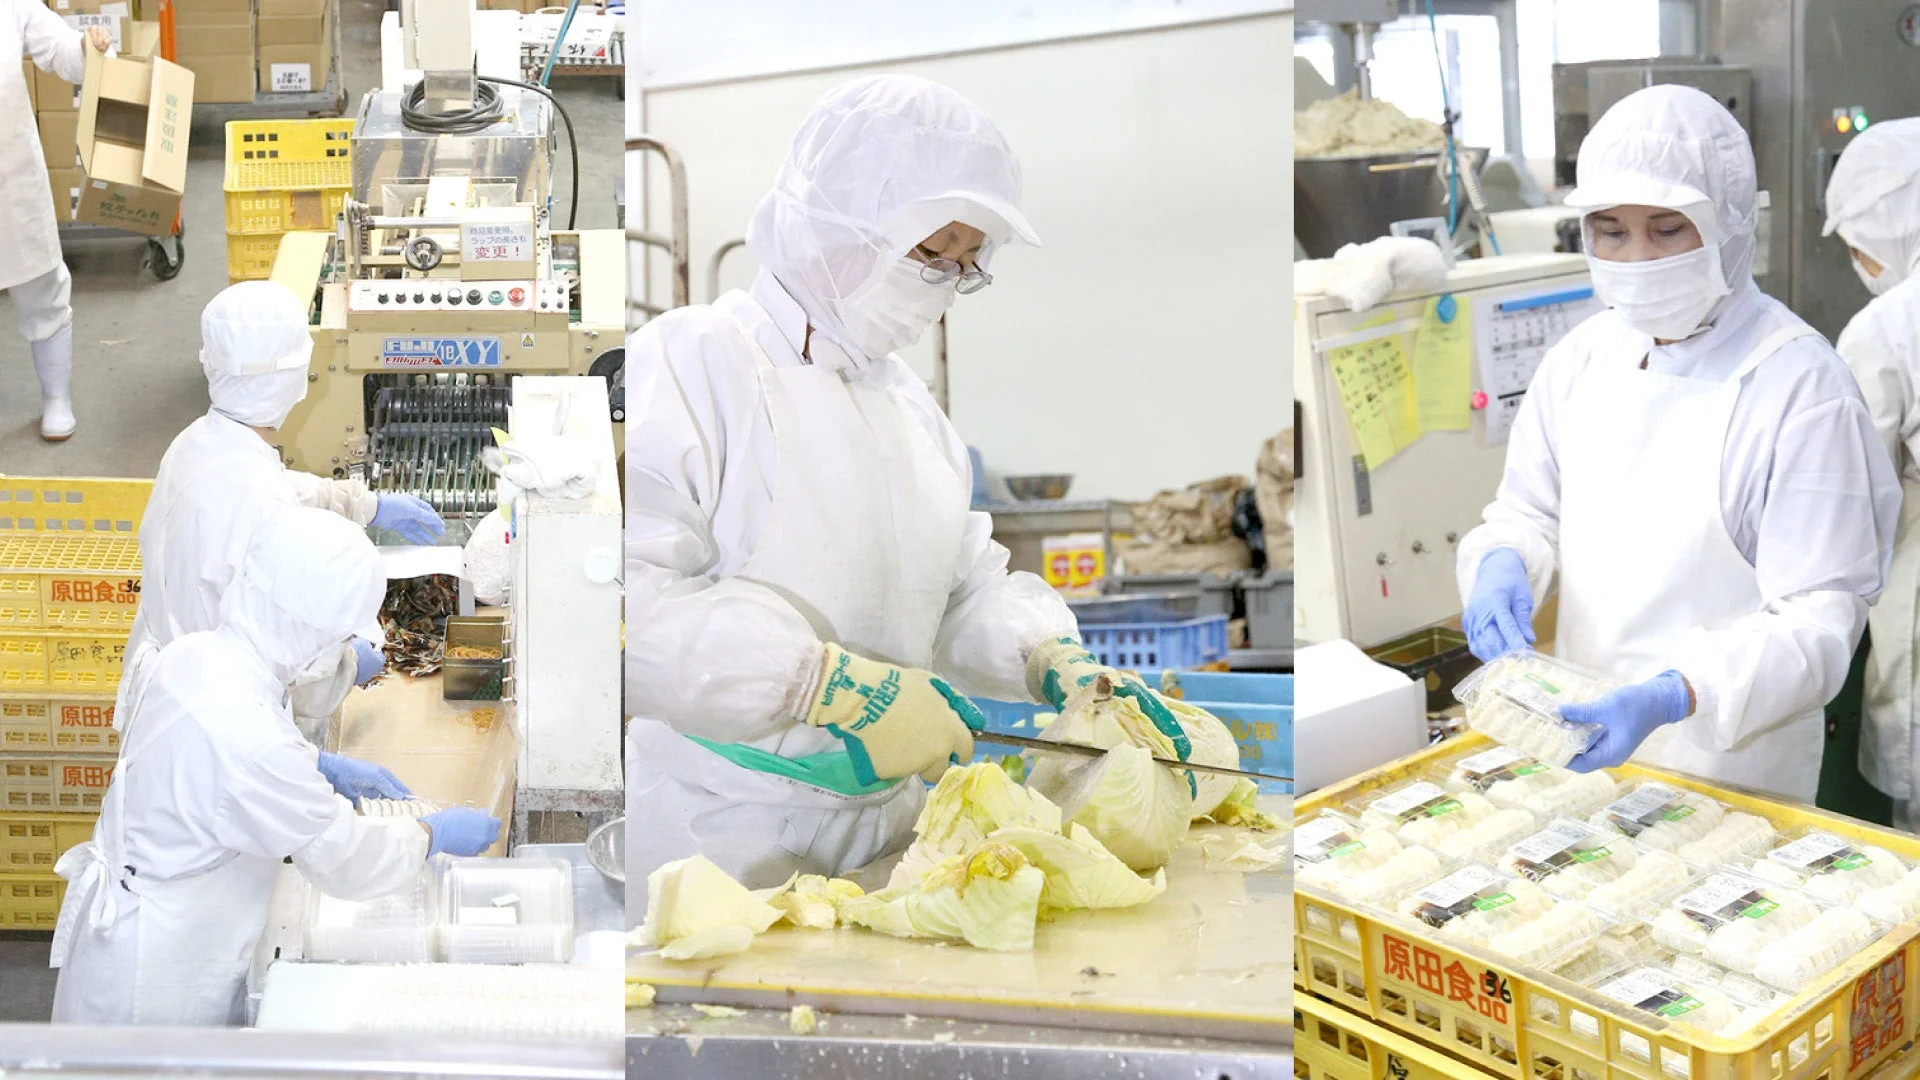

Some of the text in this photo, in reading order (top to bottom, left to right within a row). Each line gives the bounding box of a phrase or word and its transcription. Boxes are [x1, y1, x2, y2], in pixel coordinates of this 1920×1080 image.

[51, 580, 137, 604] 原田食品
[126, 579, 142, 593] 36
[1382, 934, 1508, 1025] 原田食品
[1485, 969, 1512, 1004] 36
